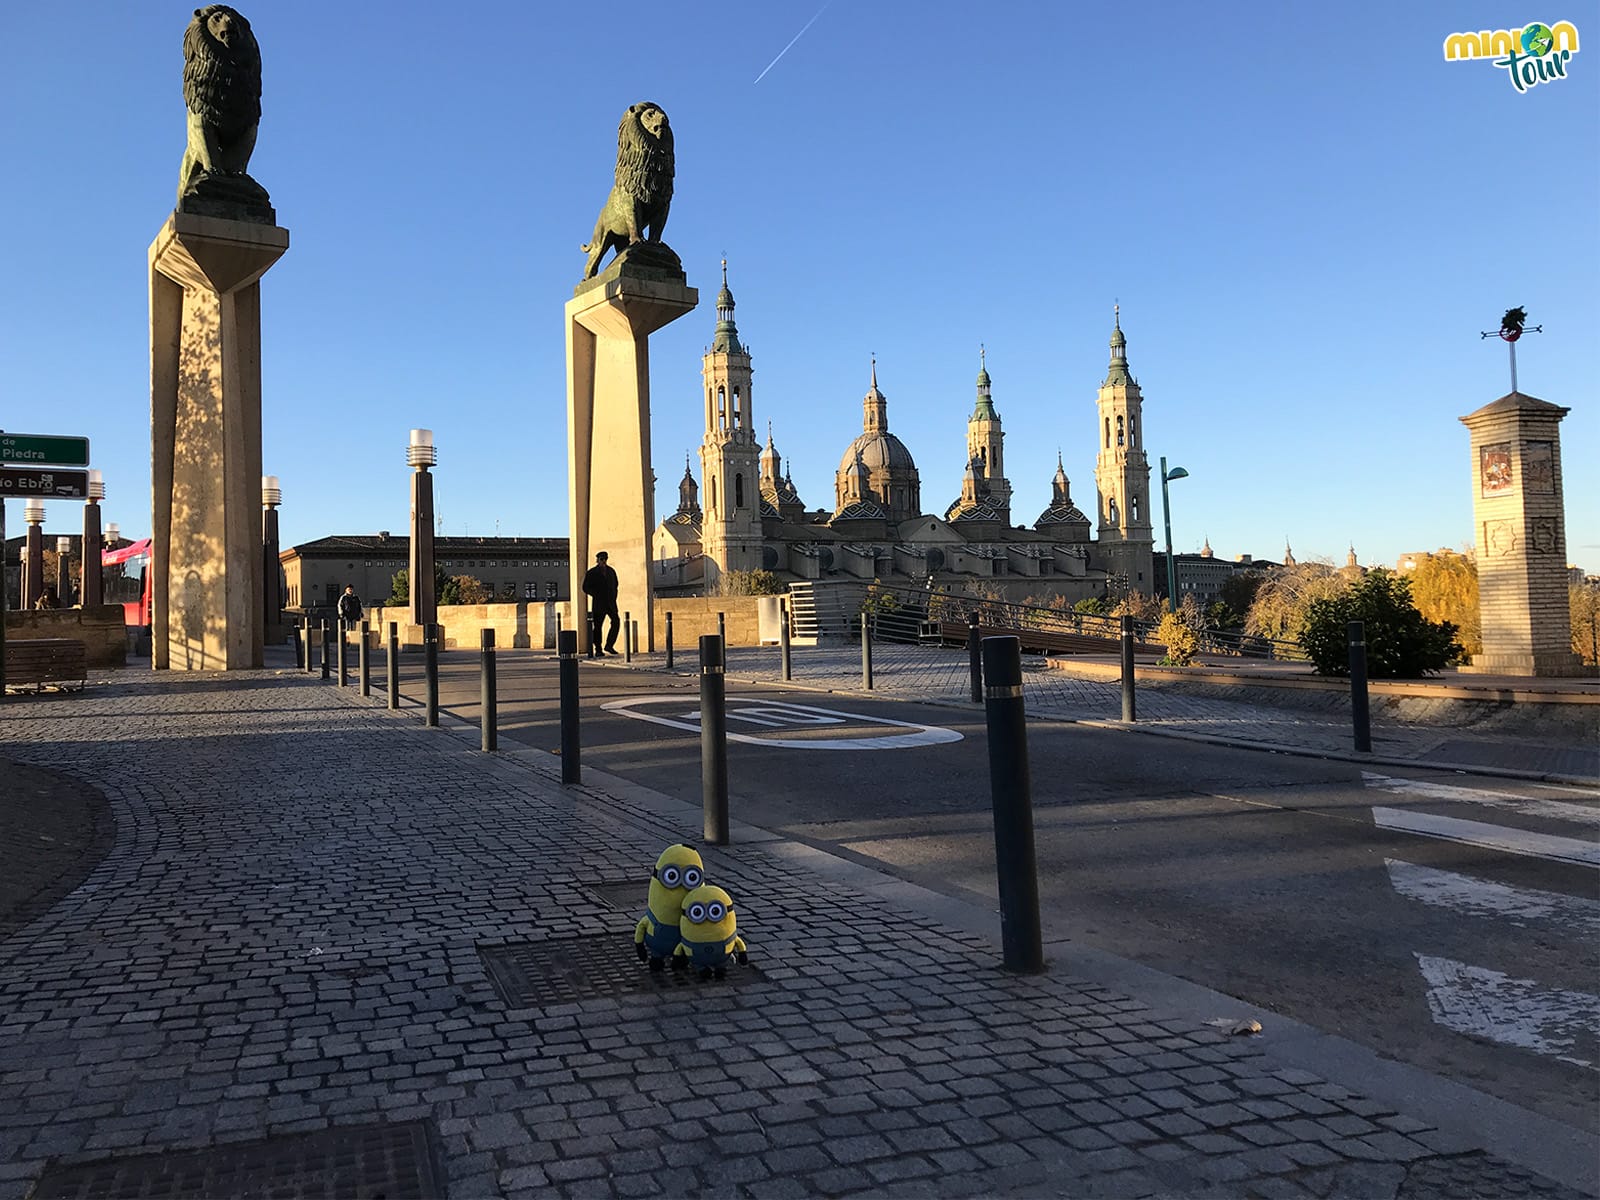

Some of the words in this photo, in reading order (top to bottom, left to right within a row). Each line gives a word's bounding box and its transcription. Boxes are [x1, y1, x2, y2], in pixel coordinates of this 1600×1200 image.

[2, 438, 16, 446] de
[2, 448, 46, 459] Piedra
[18, 477, 53, 489] Ebro
